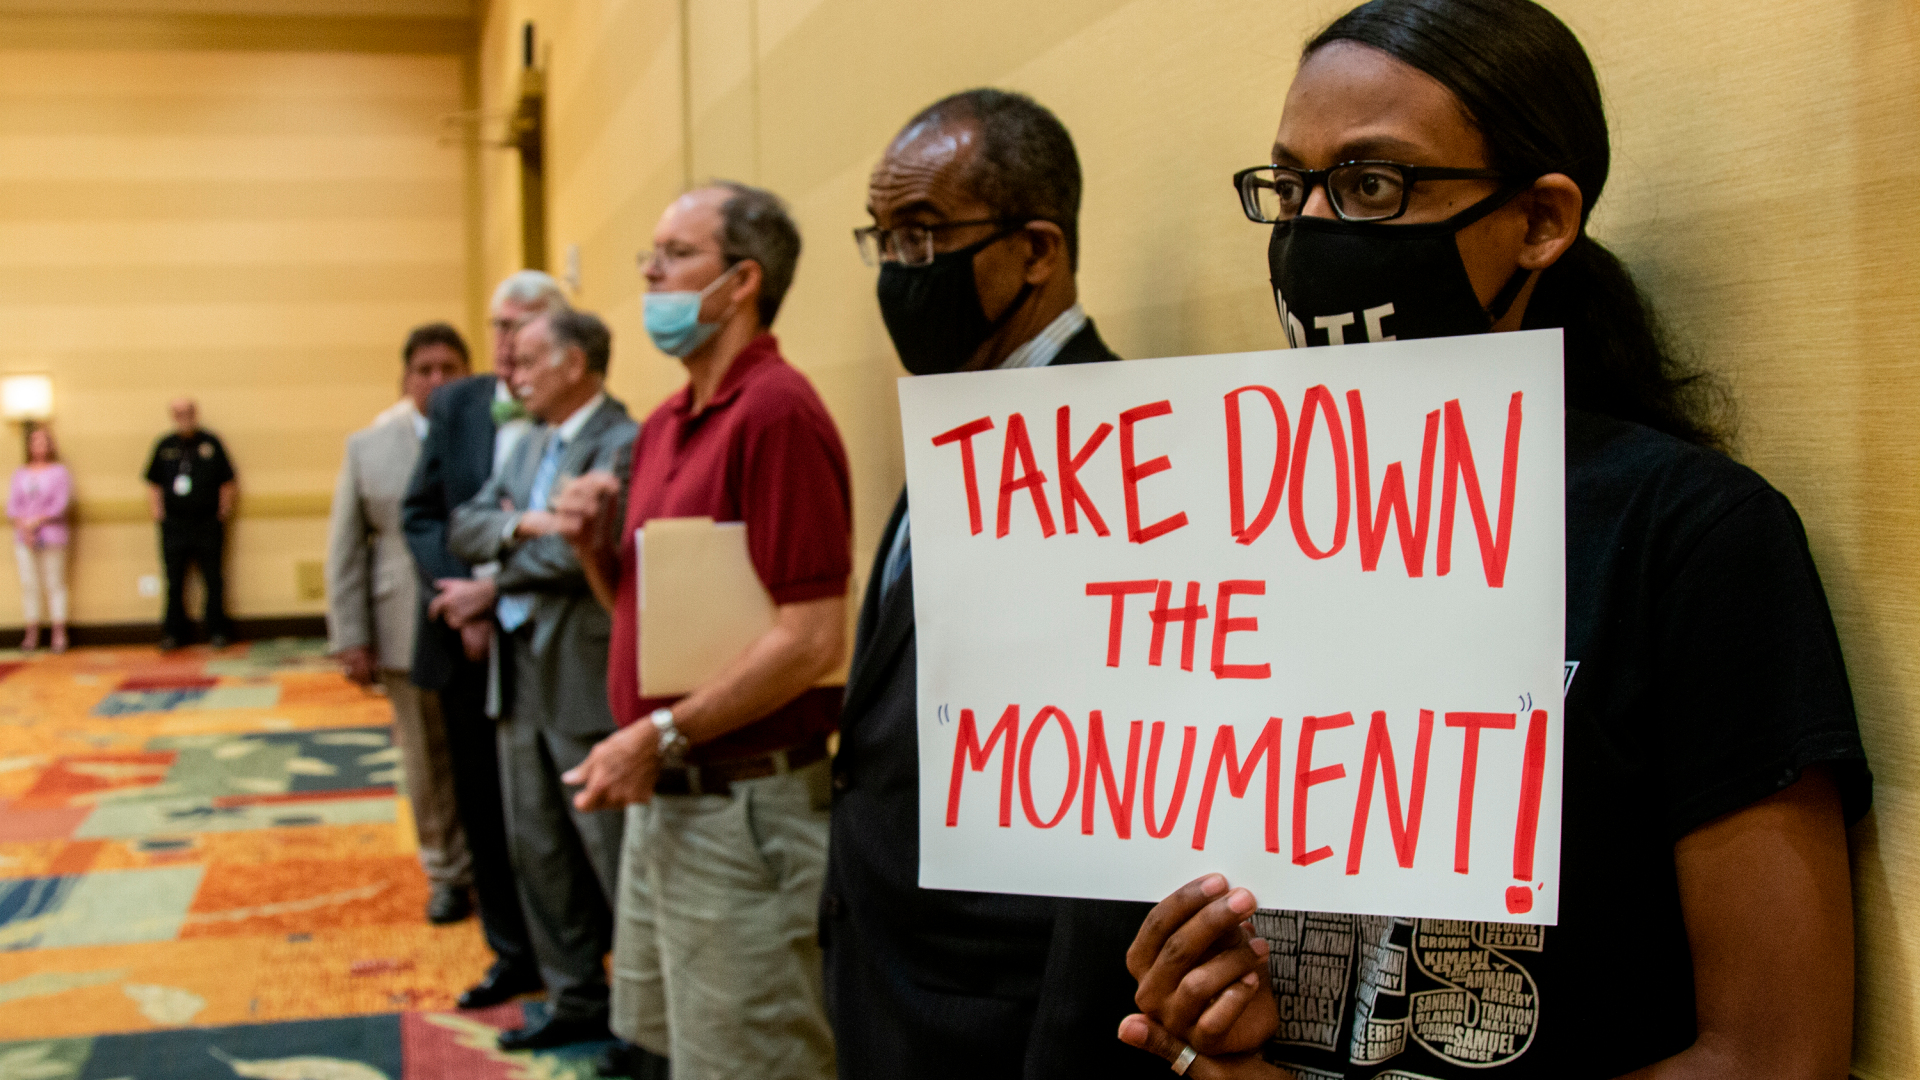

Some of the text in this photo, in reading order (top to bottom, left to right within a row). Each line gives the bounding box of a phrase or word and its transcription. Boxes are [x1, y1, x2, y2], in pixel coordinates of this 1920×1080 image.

[931, 384, 1524, 589] TAKE DOWN
[1085, 578, 1272, 680] THE
[1419, 934, 1470, 949] BROWN
[1485, 933, 1538, 946] FLOYD
[1424, 951, 1490, 966] KIMANI
[1465, 970, 1523, 992] AHMAUD
[1416, 993, 1464, 1013] SANDRA
[1481, 987, 1534, 1008] ARBERY
[1415, 1010, 1463, 1025] BLAND
[1481, 1002, 1534, 1025] TRAYVON
[1367, 1023, 1402, 1043] ERIC
[1417, 1022, 1455, 1036] JORDAN
[1481, 1019, 1529, 1035] MARTIN
[1454, 1025, 1516, 1055] SAMUEL
[1443, 1043, 1494, 1062] DUBOSE
